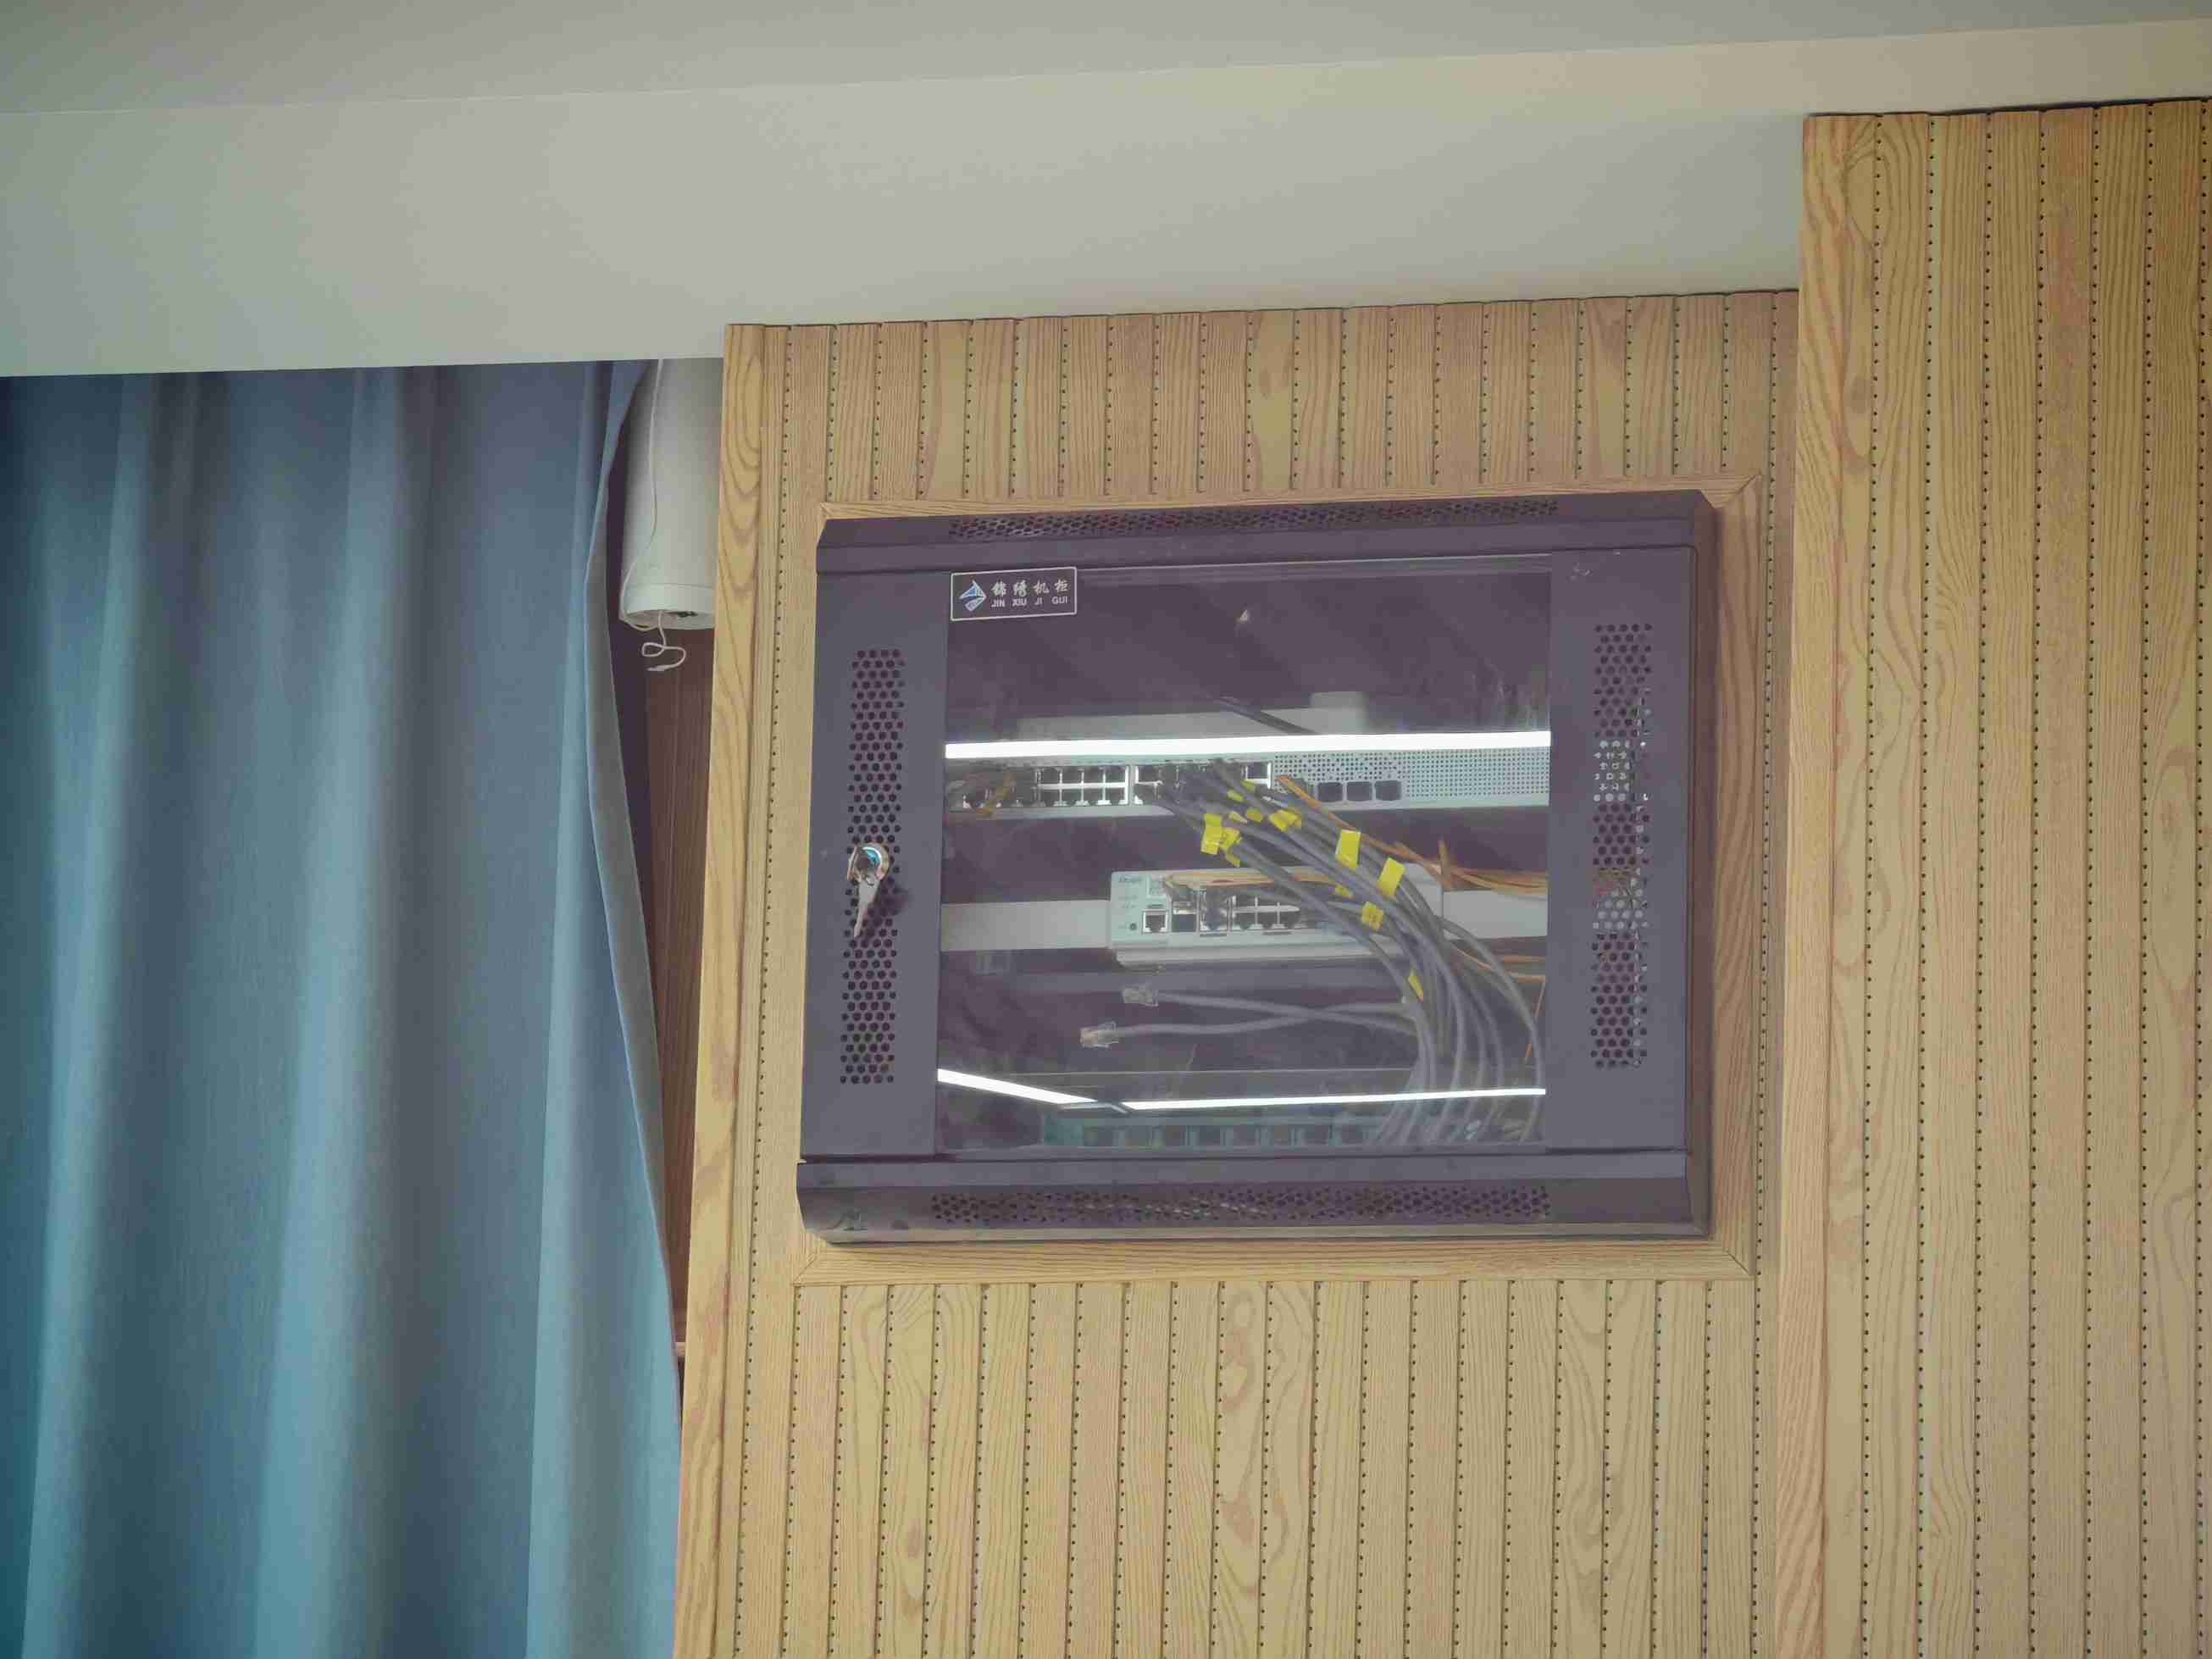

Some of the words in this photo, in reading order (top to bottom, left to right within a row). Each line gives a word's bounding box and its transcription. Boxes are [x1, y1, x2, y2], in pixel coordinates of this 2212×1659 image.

[990, 599, 1006, 608] JIN
[1012, 598, 1028, 608] XIU
[1034, 596, 1044, 606] JI
[1051, 596, 1068, 605] GUI
